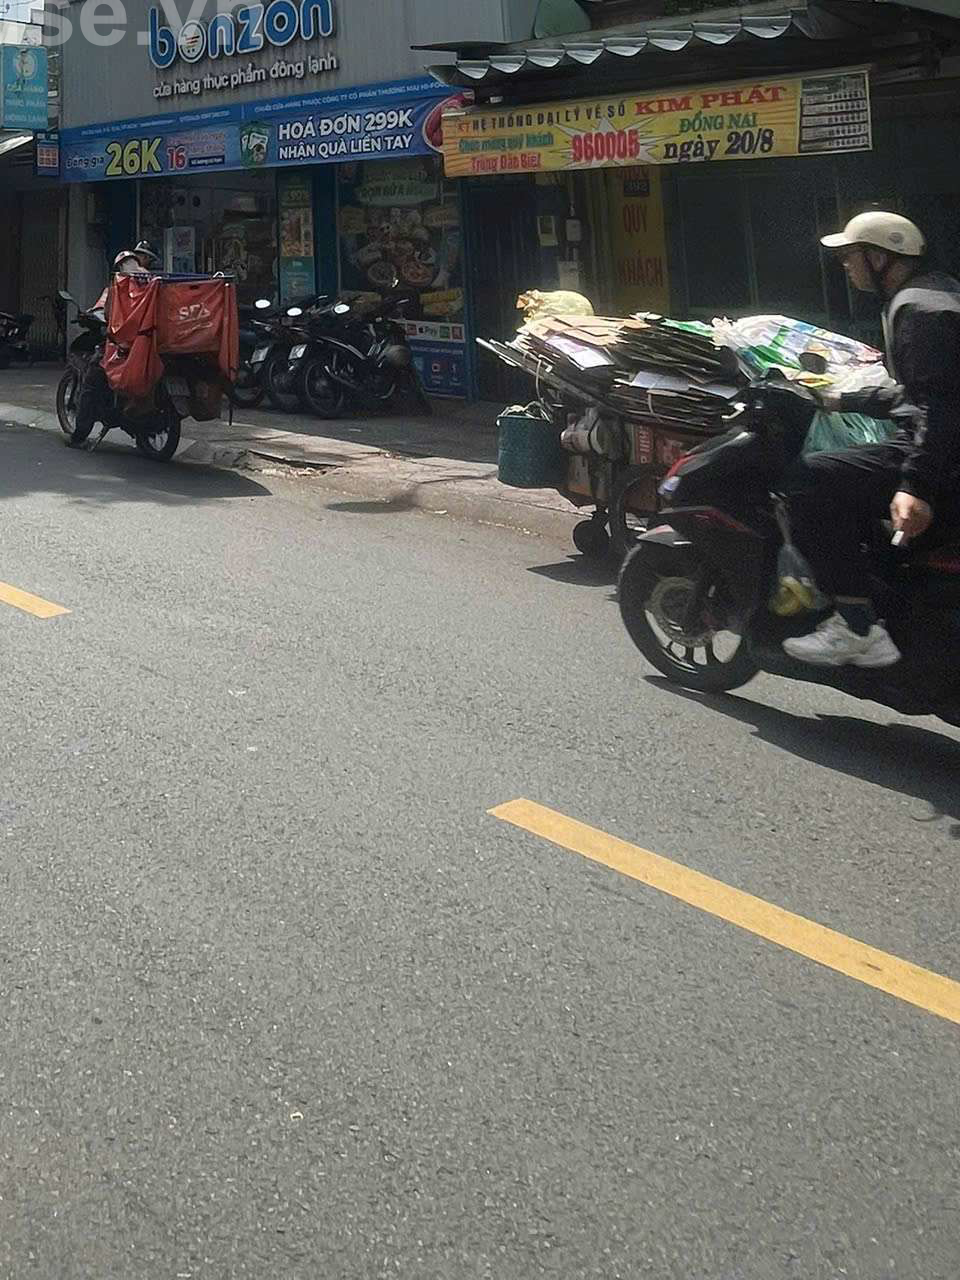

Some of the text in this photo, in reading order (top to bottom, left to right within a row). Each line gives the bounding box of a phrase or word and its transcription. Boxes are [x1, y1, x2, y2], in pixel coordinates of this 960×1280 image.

[152, 81, 172, 99] cửa
[173, 75, 201, 96] hàng
[230, 63, 266, 89] phẩm
[269, 60, 305, 80] đông
[307, 52, 337, 74] lạnh
[492, 112, 533, 130] THỐNG
[607, 99, 626, 119] SỐ
[634, 98, 693, 116] KIM
[701, 84, 788, 109] PHÁT
[278, 108, 414, 141] HOÁ ĐƠN 299K
[679, 110, 760, 134] ĐỒNG NAI
[105, 137, 163, 176] 26K
[167, 146, 187, 170] 16
[278, 143, 316, 162] NHẬN
[318, 139, 348, 159] QUÀ
[385, 134, 414, 151] TAY
[663, 134, 721, 163] ngày
[724, 127, 775, 156] 20/8
